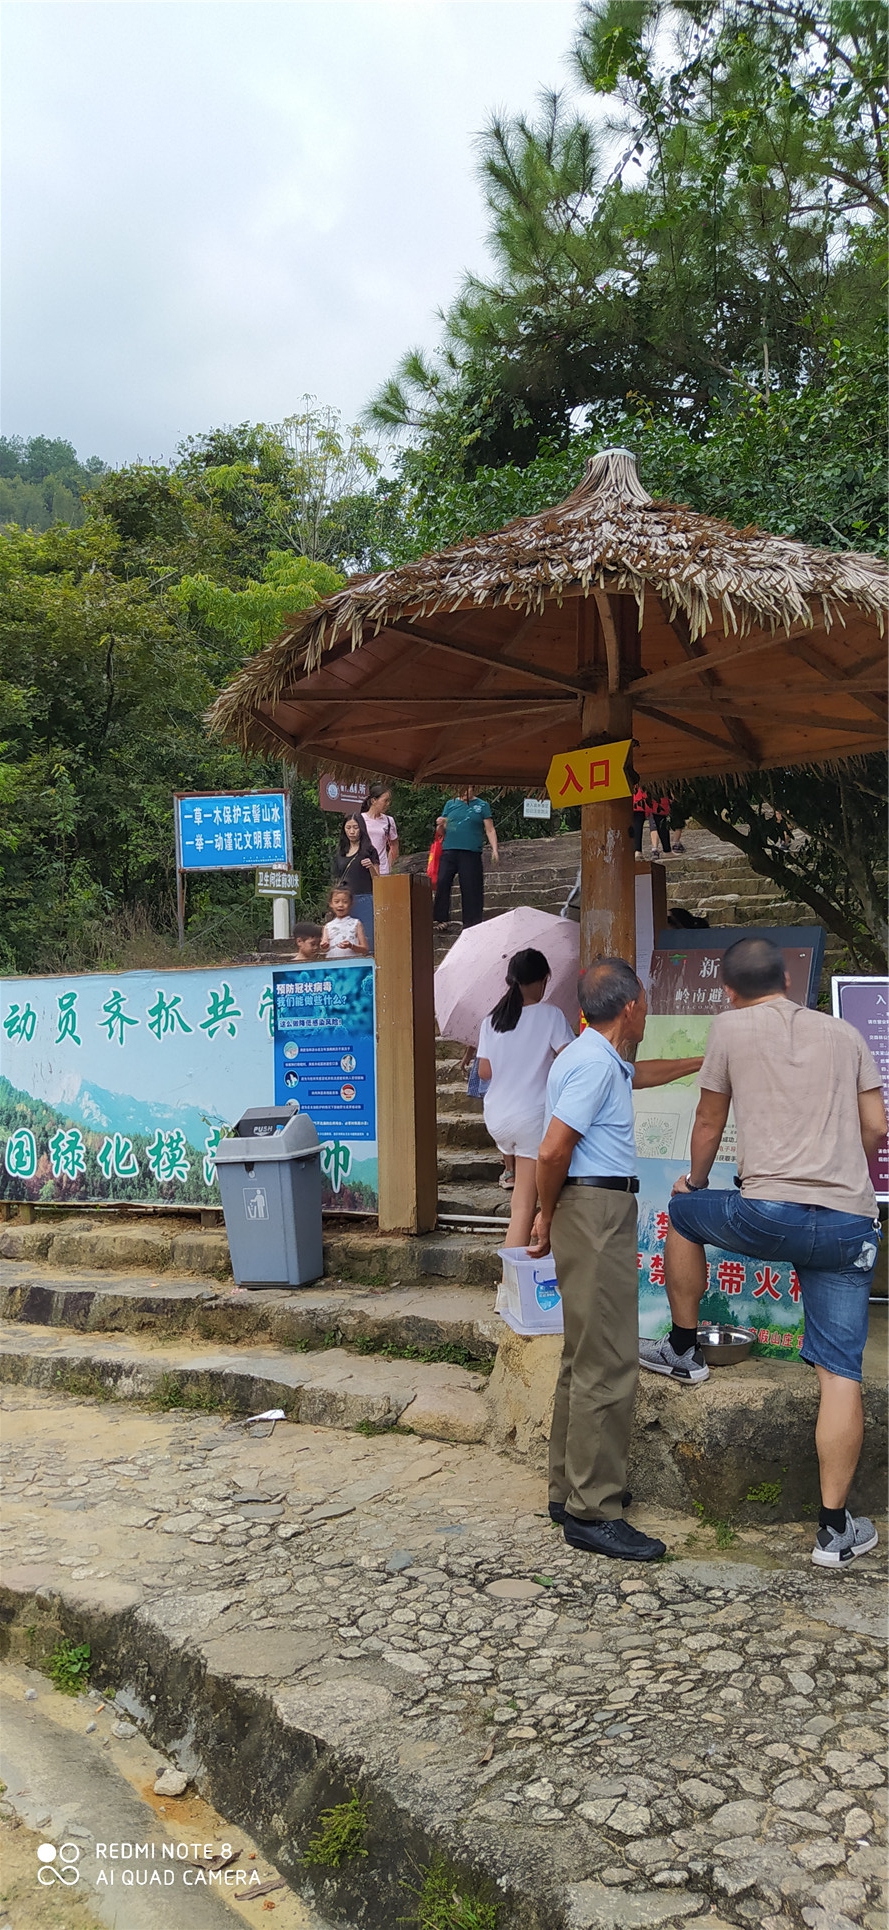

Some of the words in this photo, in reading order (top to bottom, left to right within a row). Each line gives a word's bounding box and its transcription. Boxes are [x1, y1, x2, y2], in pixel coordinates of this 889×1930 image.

[559, 760, 610, 796] 入口
[184, 804, 281, 826] 一草一木保护云髻山水
[185, 830, 282, 852] 一举一动谨记文明素质
[276, 982, 332, 995] 预防冠状病毒
[675, 987, 731, 1003] 岭南避
